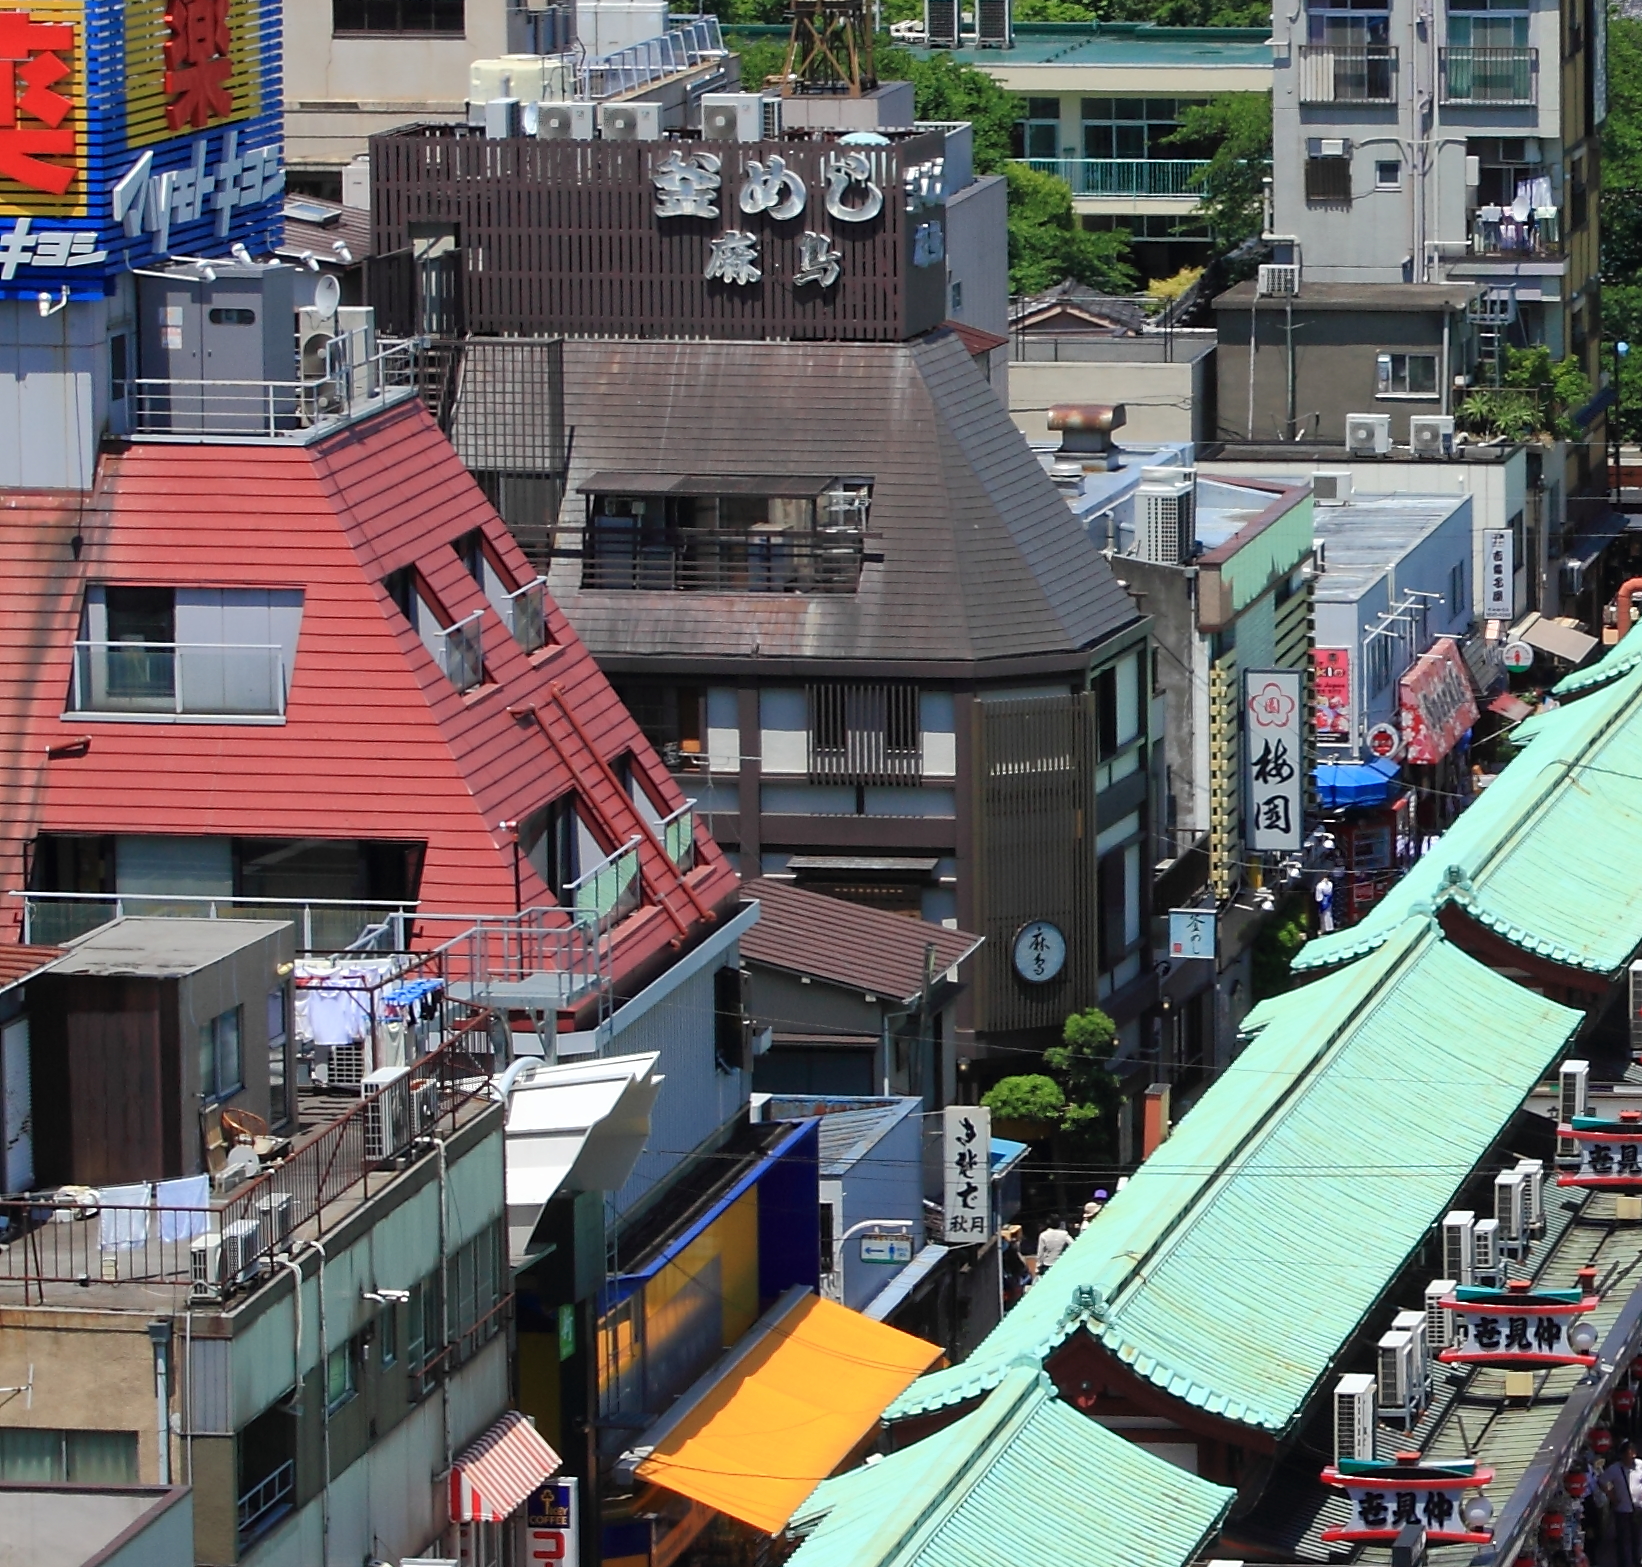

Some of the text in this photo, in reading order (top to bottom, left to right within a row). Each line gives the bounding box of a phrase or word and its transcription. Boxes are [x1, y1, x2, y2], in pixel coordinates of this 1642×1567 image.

[652, 150, 884, 223] 釜めし
[949, 1215, 986, 1234] 秋月
[529, 1515, 569, 1526] COFFEE
